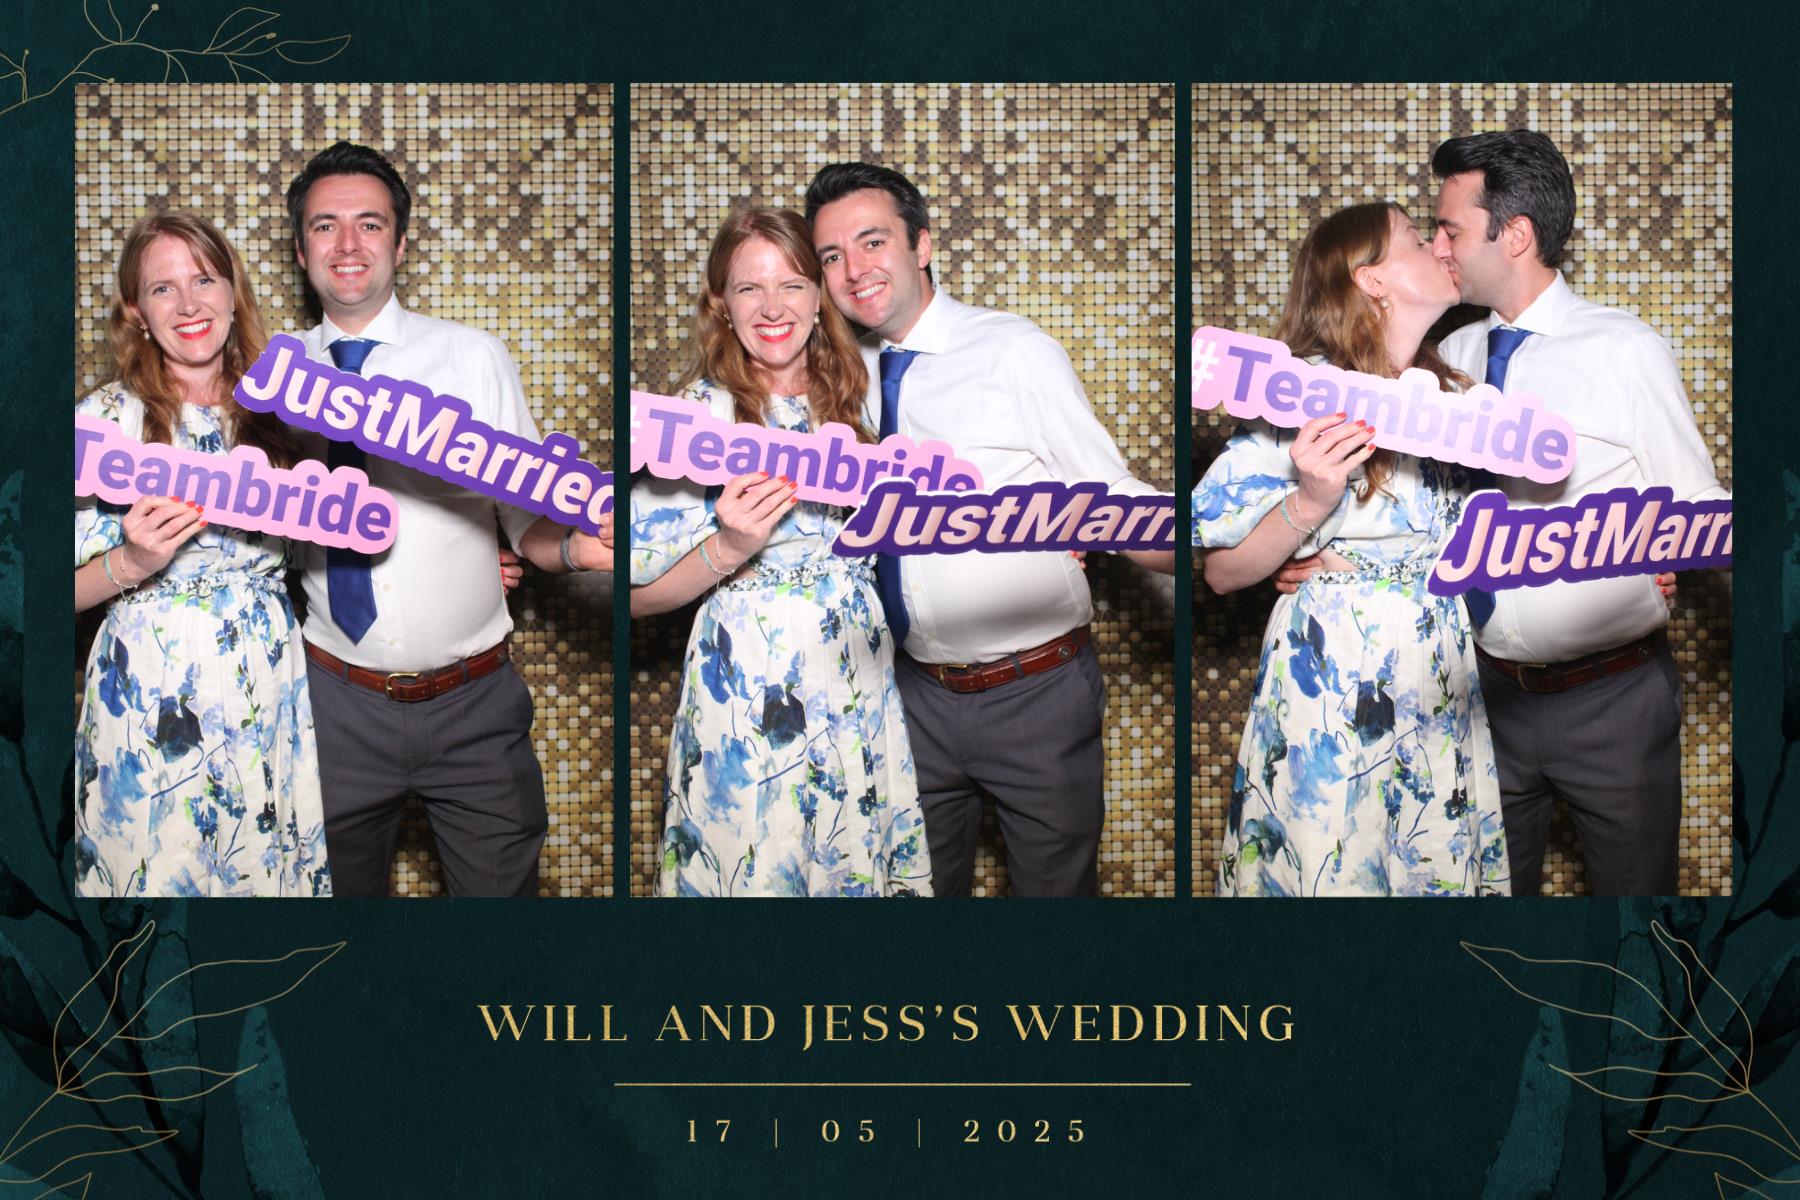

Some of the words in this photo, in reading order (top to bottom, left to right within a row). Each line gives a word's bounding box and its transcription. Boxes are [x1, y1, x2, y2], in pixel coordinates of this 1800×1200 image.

[1192, 338, 1570, 471] #Teambride
[839, 491, 1176, 548] JustMarr
[1436, 501, 1732, 582] JustMarr
